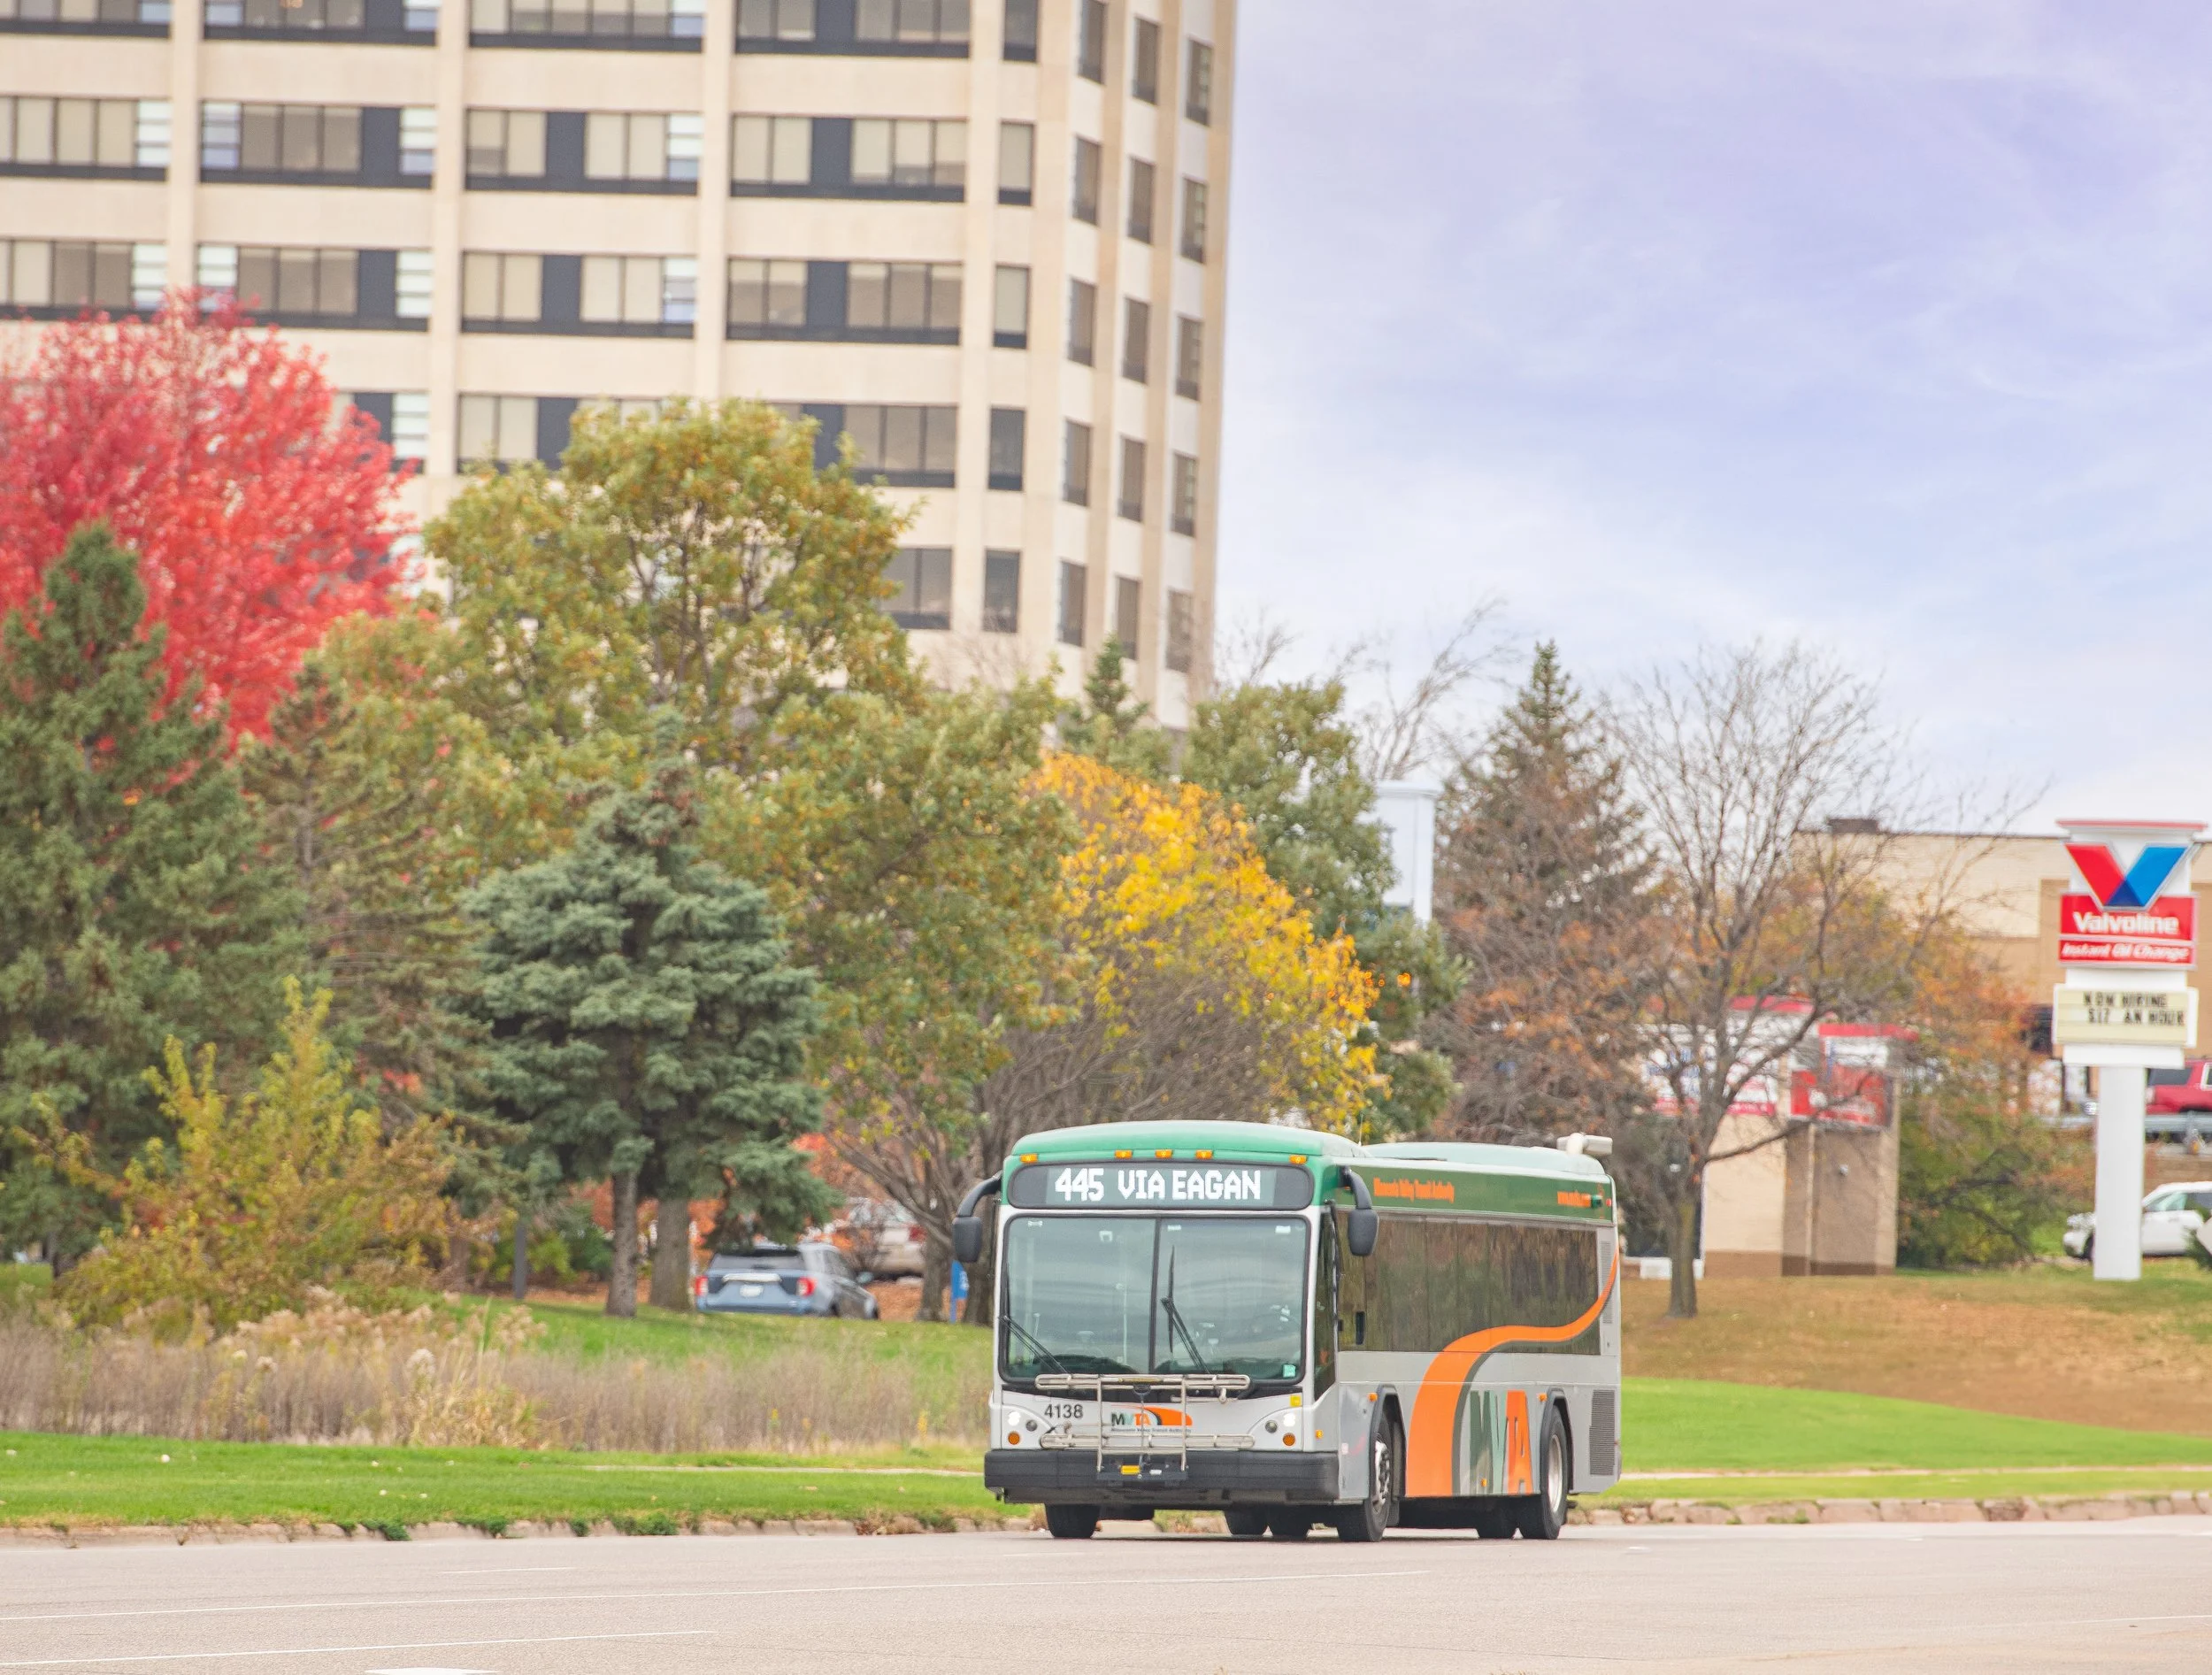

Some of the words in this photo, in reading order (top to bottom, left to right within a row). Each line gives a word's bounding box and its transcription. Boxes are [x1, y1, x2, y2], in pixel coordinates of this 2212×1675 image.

[2072, 911, 2179, 934] Valvoline
[2062, 942, 2110, 957] Instant
[2111, 943, 2131, 957] Oil
[2133, 943, 2189, 961] Change
[2084, 992, 2115, 1006] NOW
[2123, 993, 2166, 1007] HIRING
[2125, 1010, 2142, 1025] AN
[2149, 1010, 2184, 1026] HOUR
[1055, 1168, 1104, 1202] 445
[1118, 1169, 1165, 1200] VIA
[1172, 1169, 1261, 1200] EAGAN
[1044, 1404, 1083, 1418] 4138
